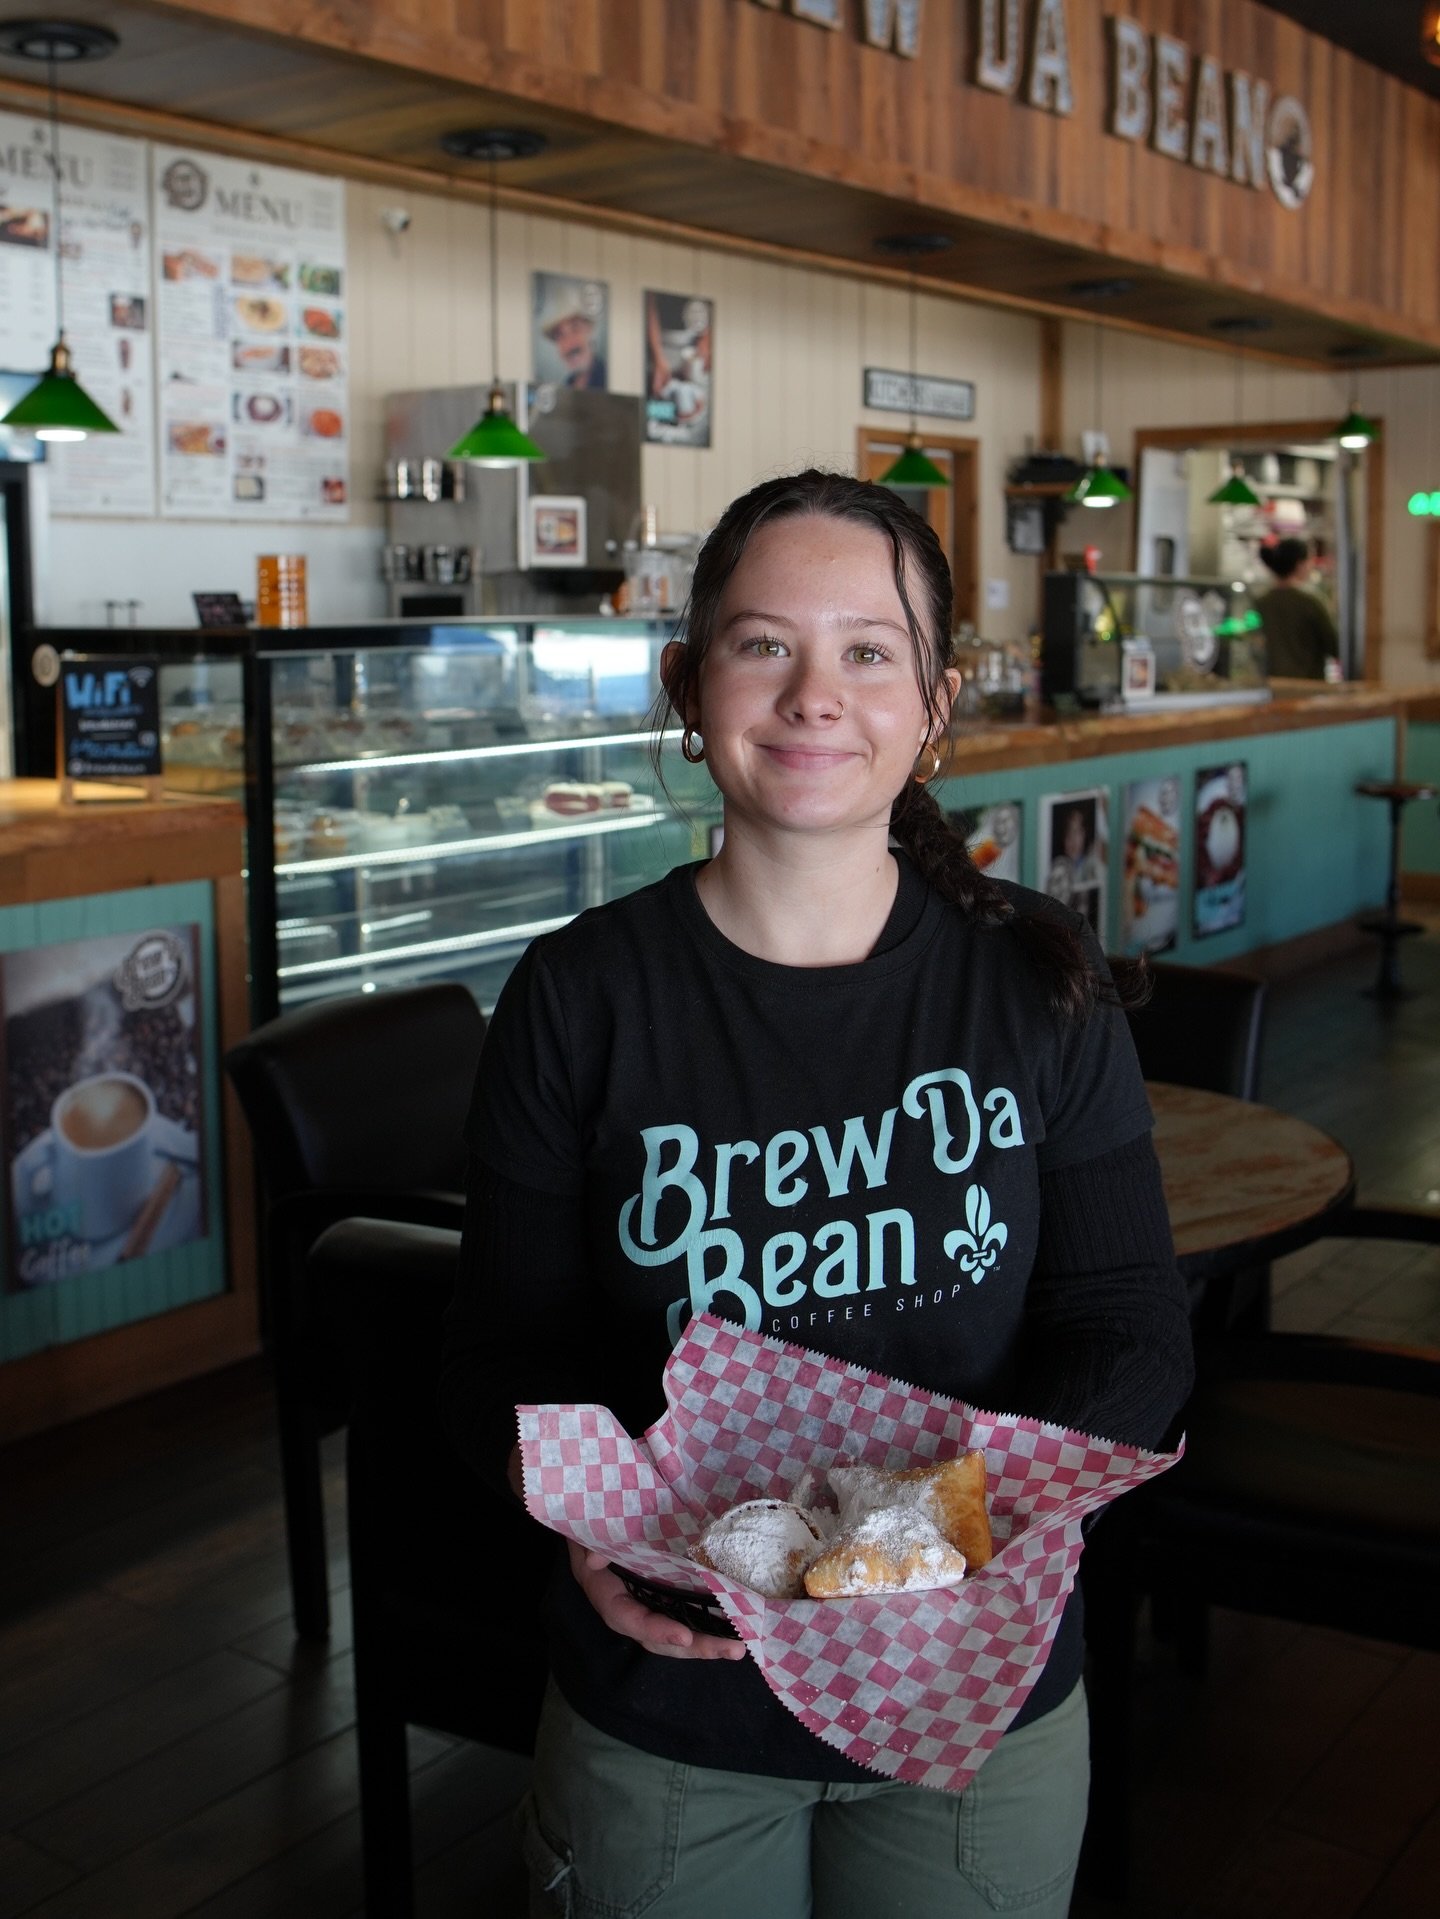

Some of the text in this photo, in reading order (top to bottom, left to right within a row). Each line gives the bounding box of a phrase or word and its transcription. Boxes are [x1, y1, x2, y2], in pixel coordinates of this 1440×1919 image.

[1110, 14, 1270, 193] BEAN
[214, 185, 303, 231] MENU
[618, 1066, 1026, 1267] Brew Da
[666, 1206, 918, 1350] Bean
[772, 1283, 961, 1333] COFFEE SHOP
